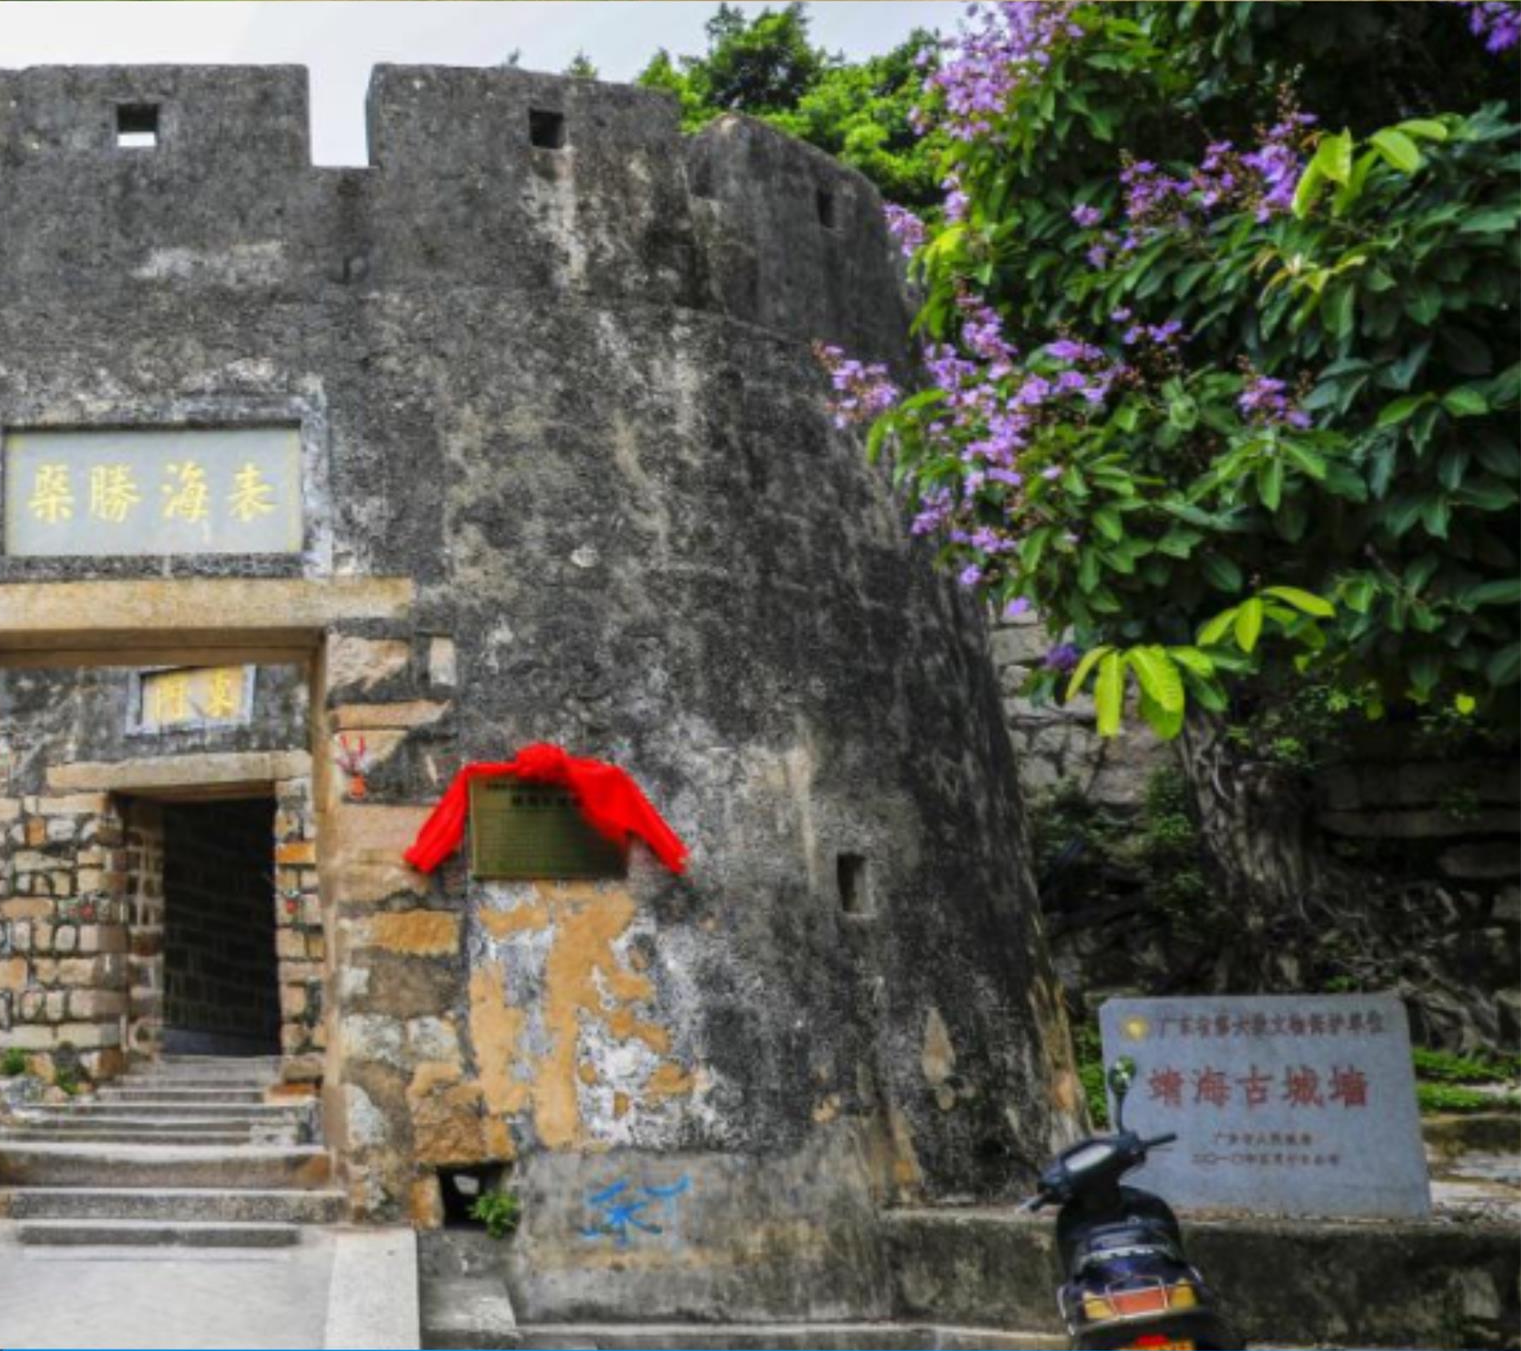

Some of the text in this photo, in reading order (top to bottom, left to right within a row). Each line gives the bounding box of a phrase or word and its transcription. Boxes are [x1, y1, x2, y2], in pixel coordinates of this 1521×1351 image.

[1148, 1064, 1368, 1109] 靖海古城墙
